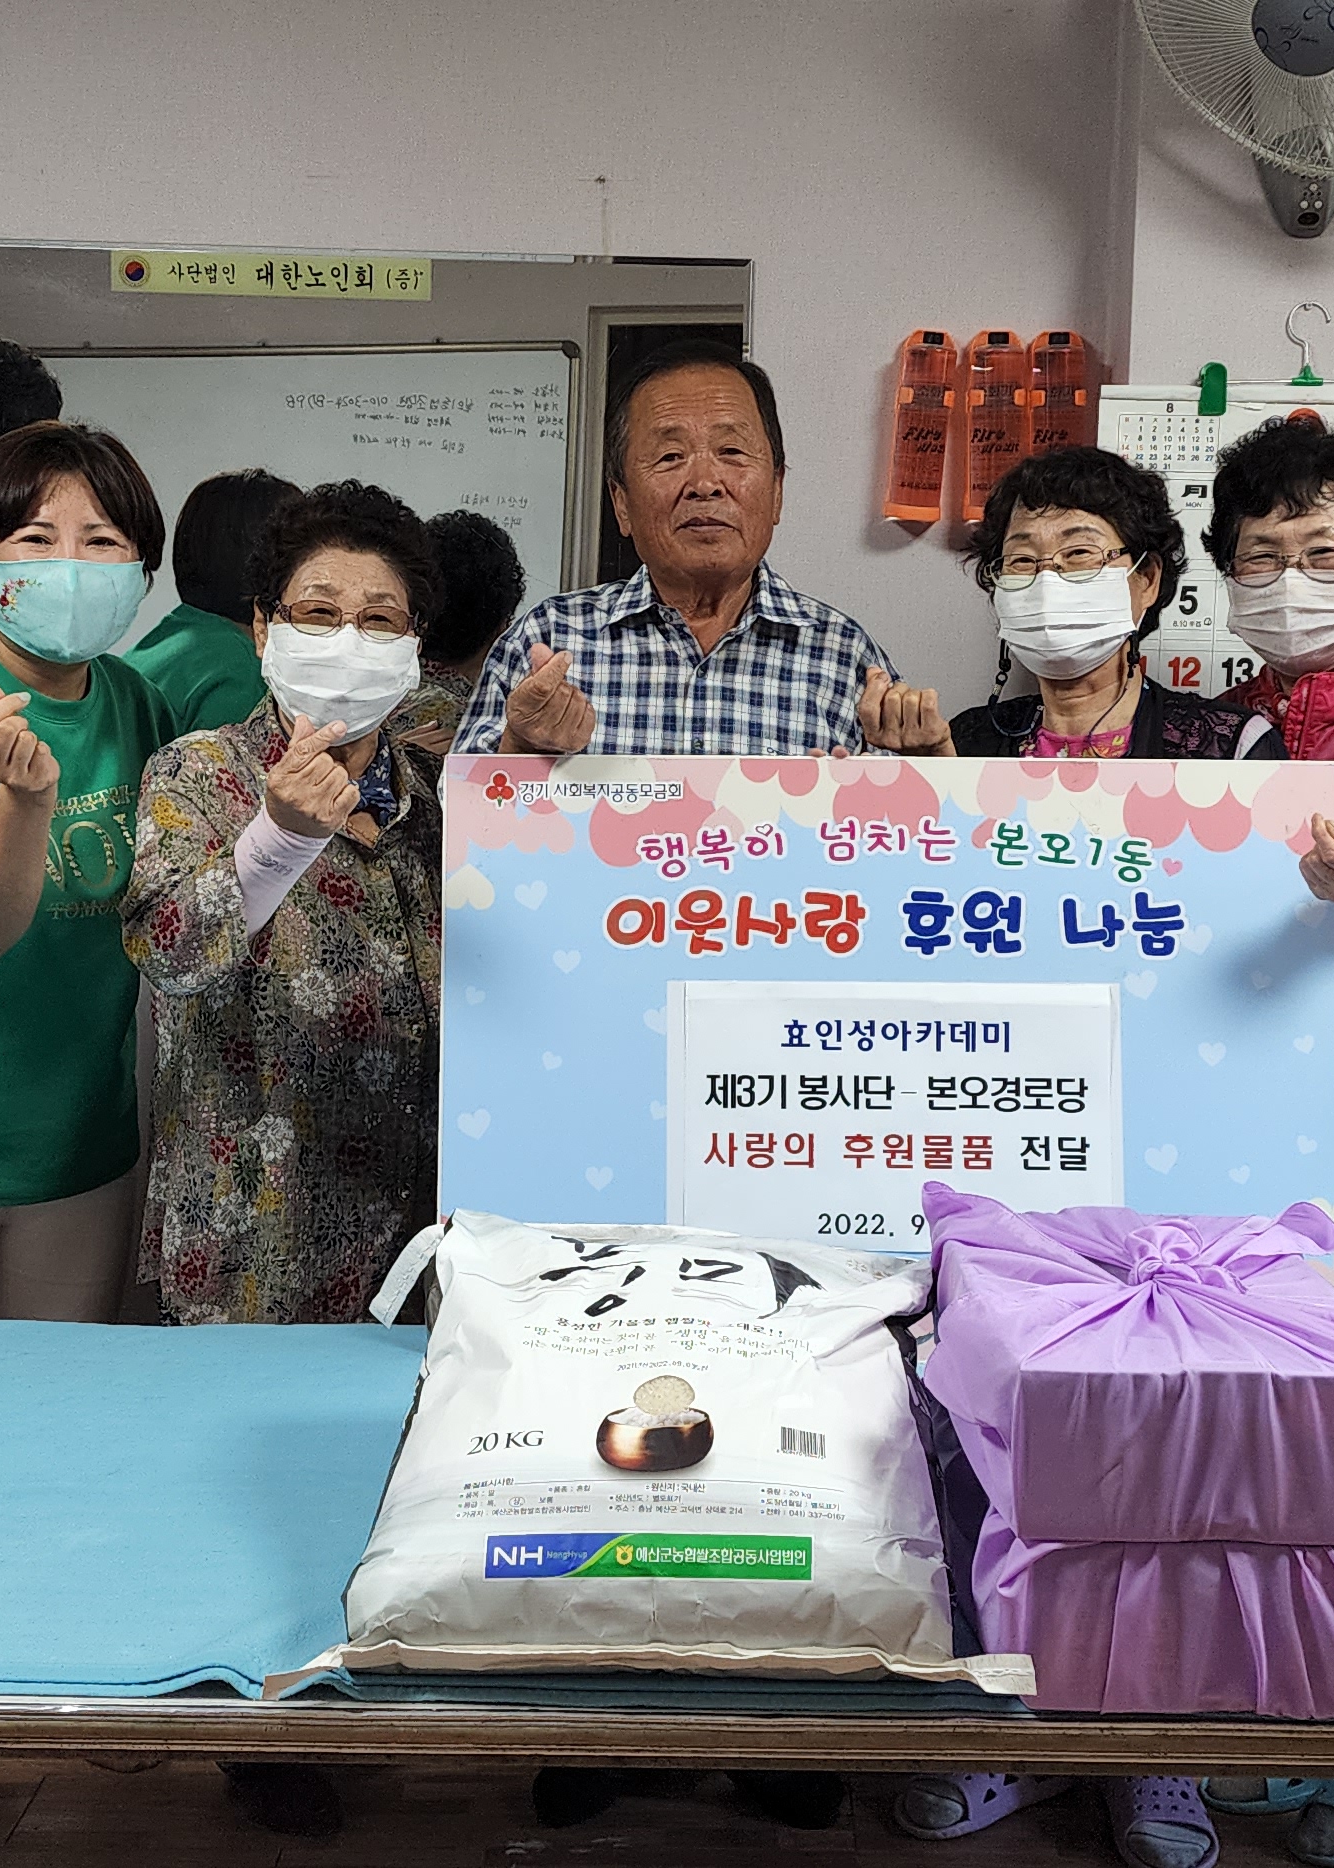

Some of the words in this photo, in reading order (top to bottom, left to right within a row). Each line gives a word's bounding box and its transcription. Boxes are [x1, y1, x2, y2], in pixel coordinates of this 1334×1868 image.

[168, 261, 236, 284] 사단법인
[256, 262, 373, 293] 대한노인회
[1166, 403, 1174, 413] 8
[1181, 484, 1208, 499] 月
[1178, 585, 1199, 616] 5
[1168, 656, 1202, 688] 12
[1221, 657, 1255, 688] 13
[519, 782, 549, 803] 경기
[553, 782, 682, 803] 사회복지공동모금회
[641, 824, 785, 879] 행복이
[820, 821, 956, 862] 넘치는
[991, 823, 1154, 883] 본오1동
[606, 890, 866, 956] 이웃사랑
[903, 890, 1023, 955] 후원
[1061, 892, 1185, 957] 나눔
[781, 1020, 1011, 1053] 효인성아카데미
[705, 1074, 788, 1110] 제3기
[798, 1075, 895, 1110] 봉사단
[928, 1076, 1089, 1114] 본오경로당
[705, 1133, 815, 1169] 사랑의
[843, 1134, 994, 1170] 후원물품
[1021, 1136, 1090, 1172] 전달
[818, 1213, 895, 1238] 2022.
[910, 1214, 925, 1237] 9
[467, 1431, 499, 1455] 20
[506, 1430, 545, 1449] KG
[651, 1482, 676, 1492] 원산지
[681, 1482, 706, 1493] 국내산
[808, 1511, 846, 1521] 337-0167
[493, 1545, 544, 1566] NH
[636, 1546, 806, 1566] 예산군농협쌀조합공동사업법인
